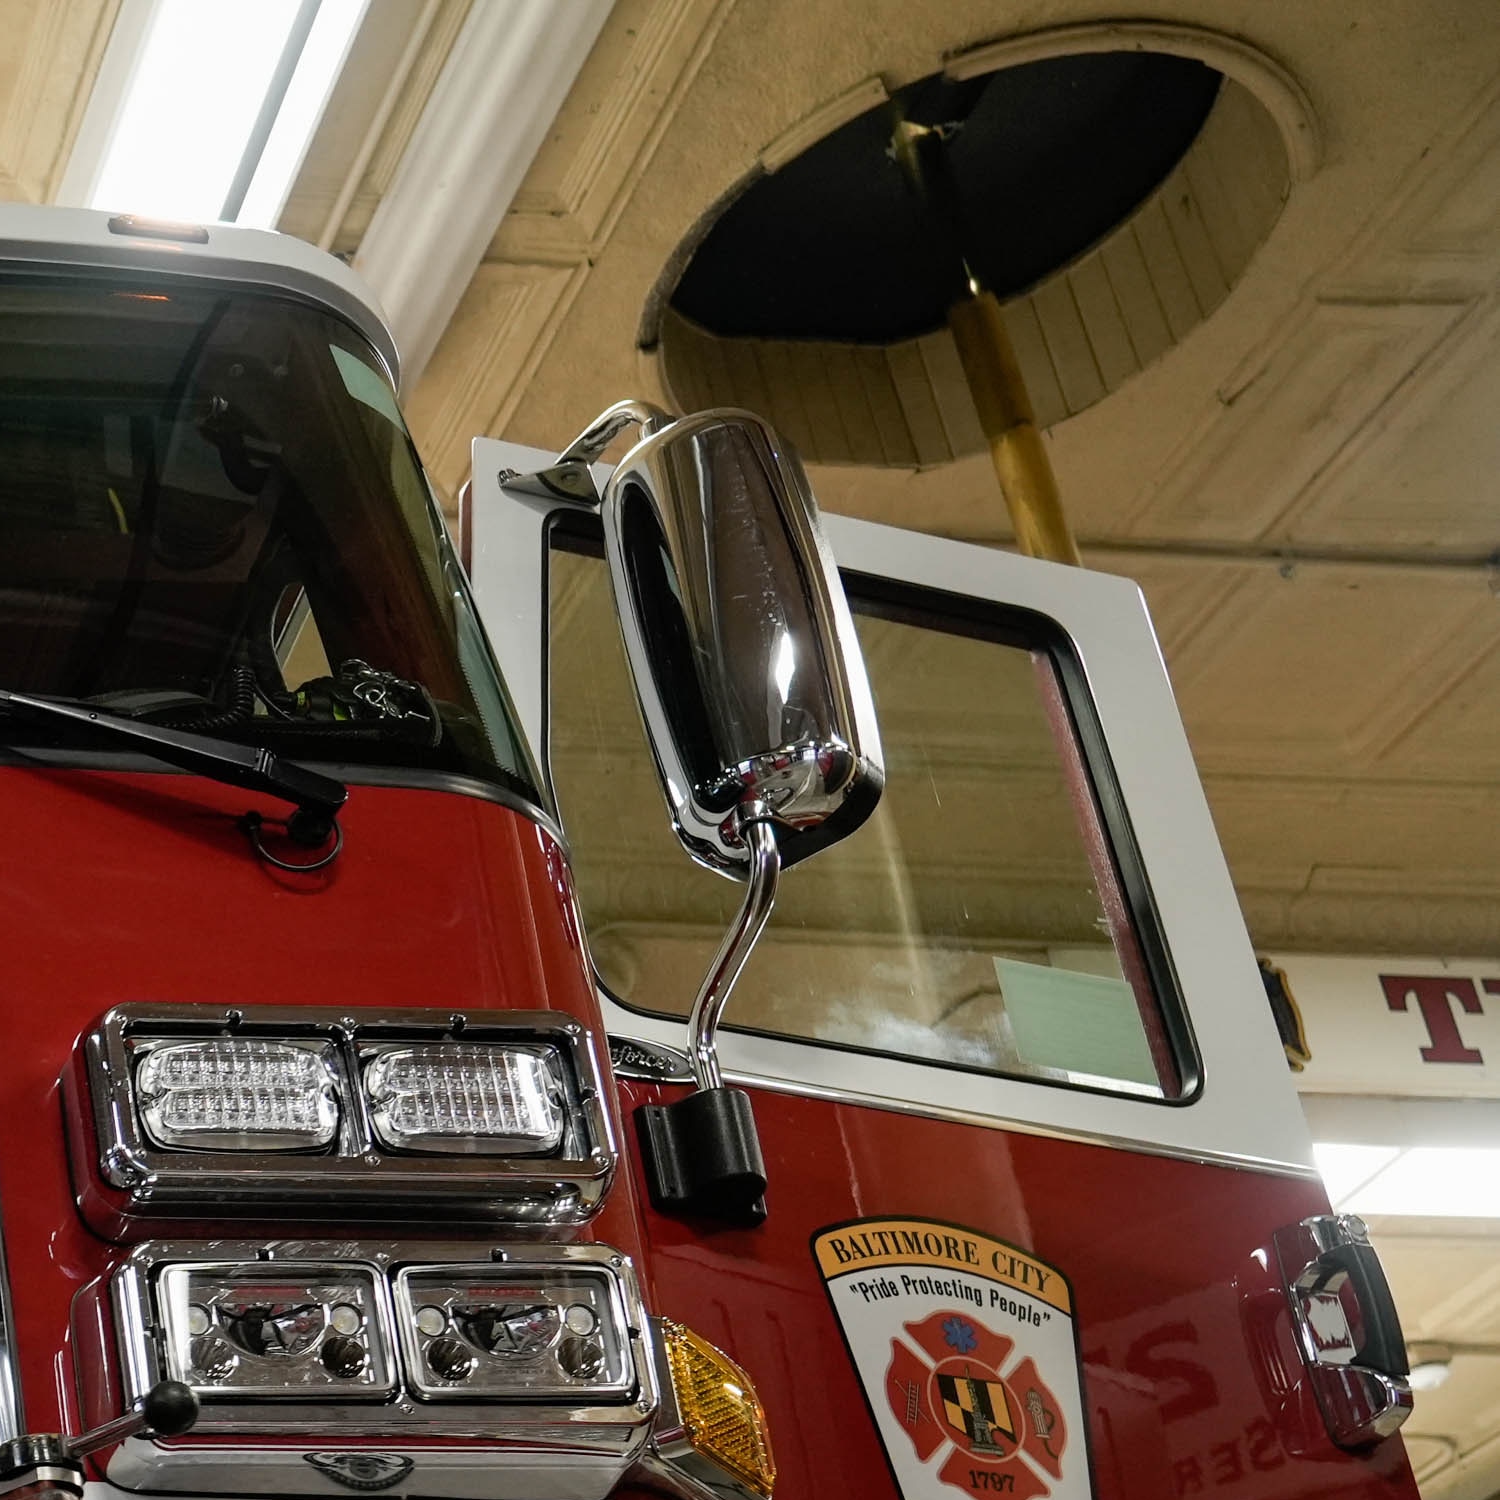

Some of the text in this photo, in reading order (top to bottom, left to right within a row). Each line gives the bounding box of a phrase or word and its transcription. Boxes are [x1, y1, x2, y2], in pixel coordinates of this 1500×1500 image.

[829, 1230, 1051, 1294] BALTIMORE CITY
[901, 1274, 983, 1307] Protecting
[968, 1469, 1016, 1493] 1797
